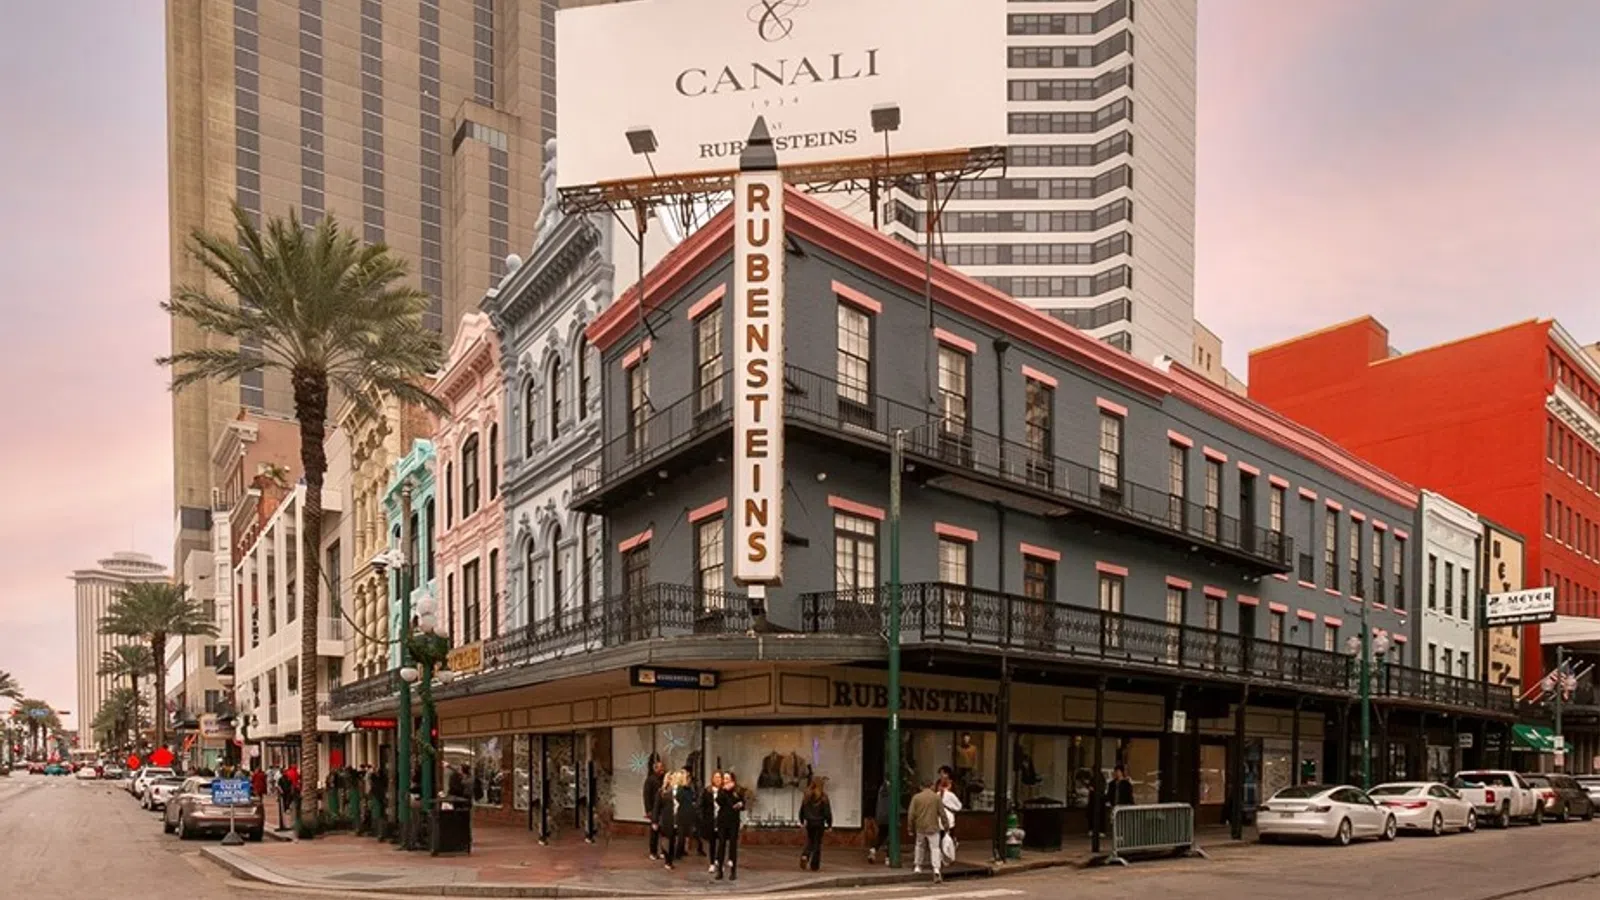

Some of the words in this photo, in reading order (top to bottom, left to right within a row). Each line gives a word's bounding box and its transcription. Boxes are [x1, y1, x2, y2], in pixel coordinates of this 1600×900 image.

[675, 48, 880, 97] CANALI
[699, 129, 857, 159] RUBSTEINS
[745, 183, 770, 563] RUBENSTEINS
[1508, 592, 1551, 604] MEYER
